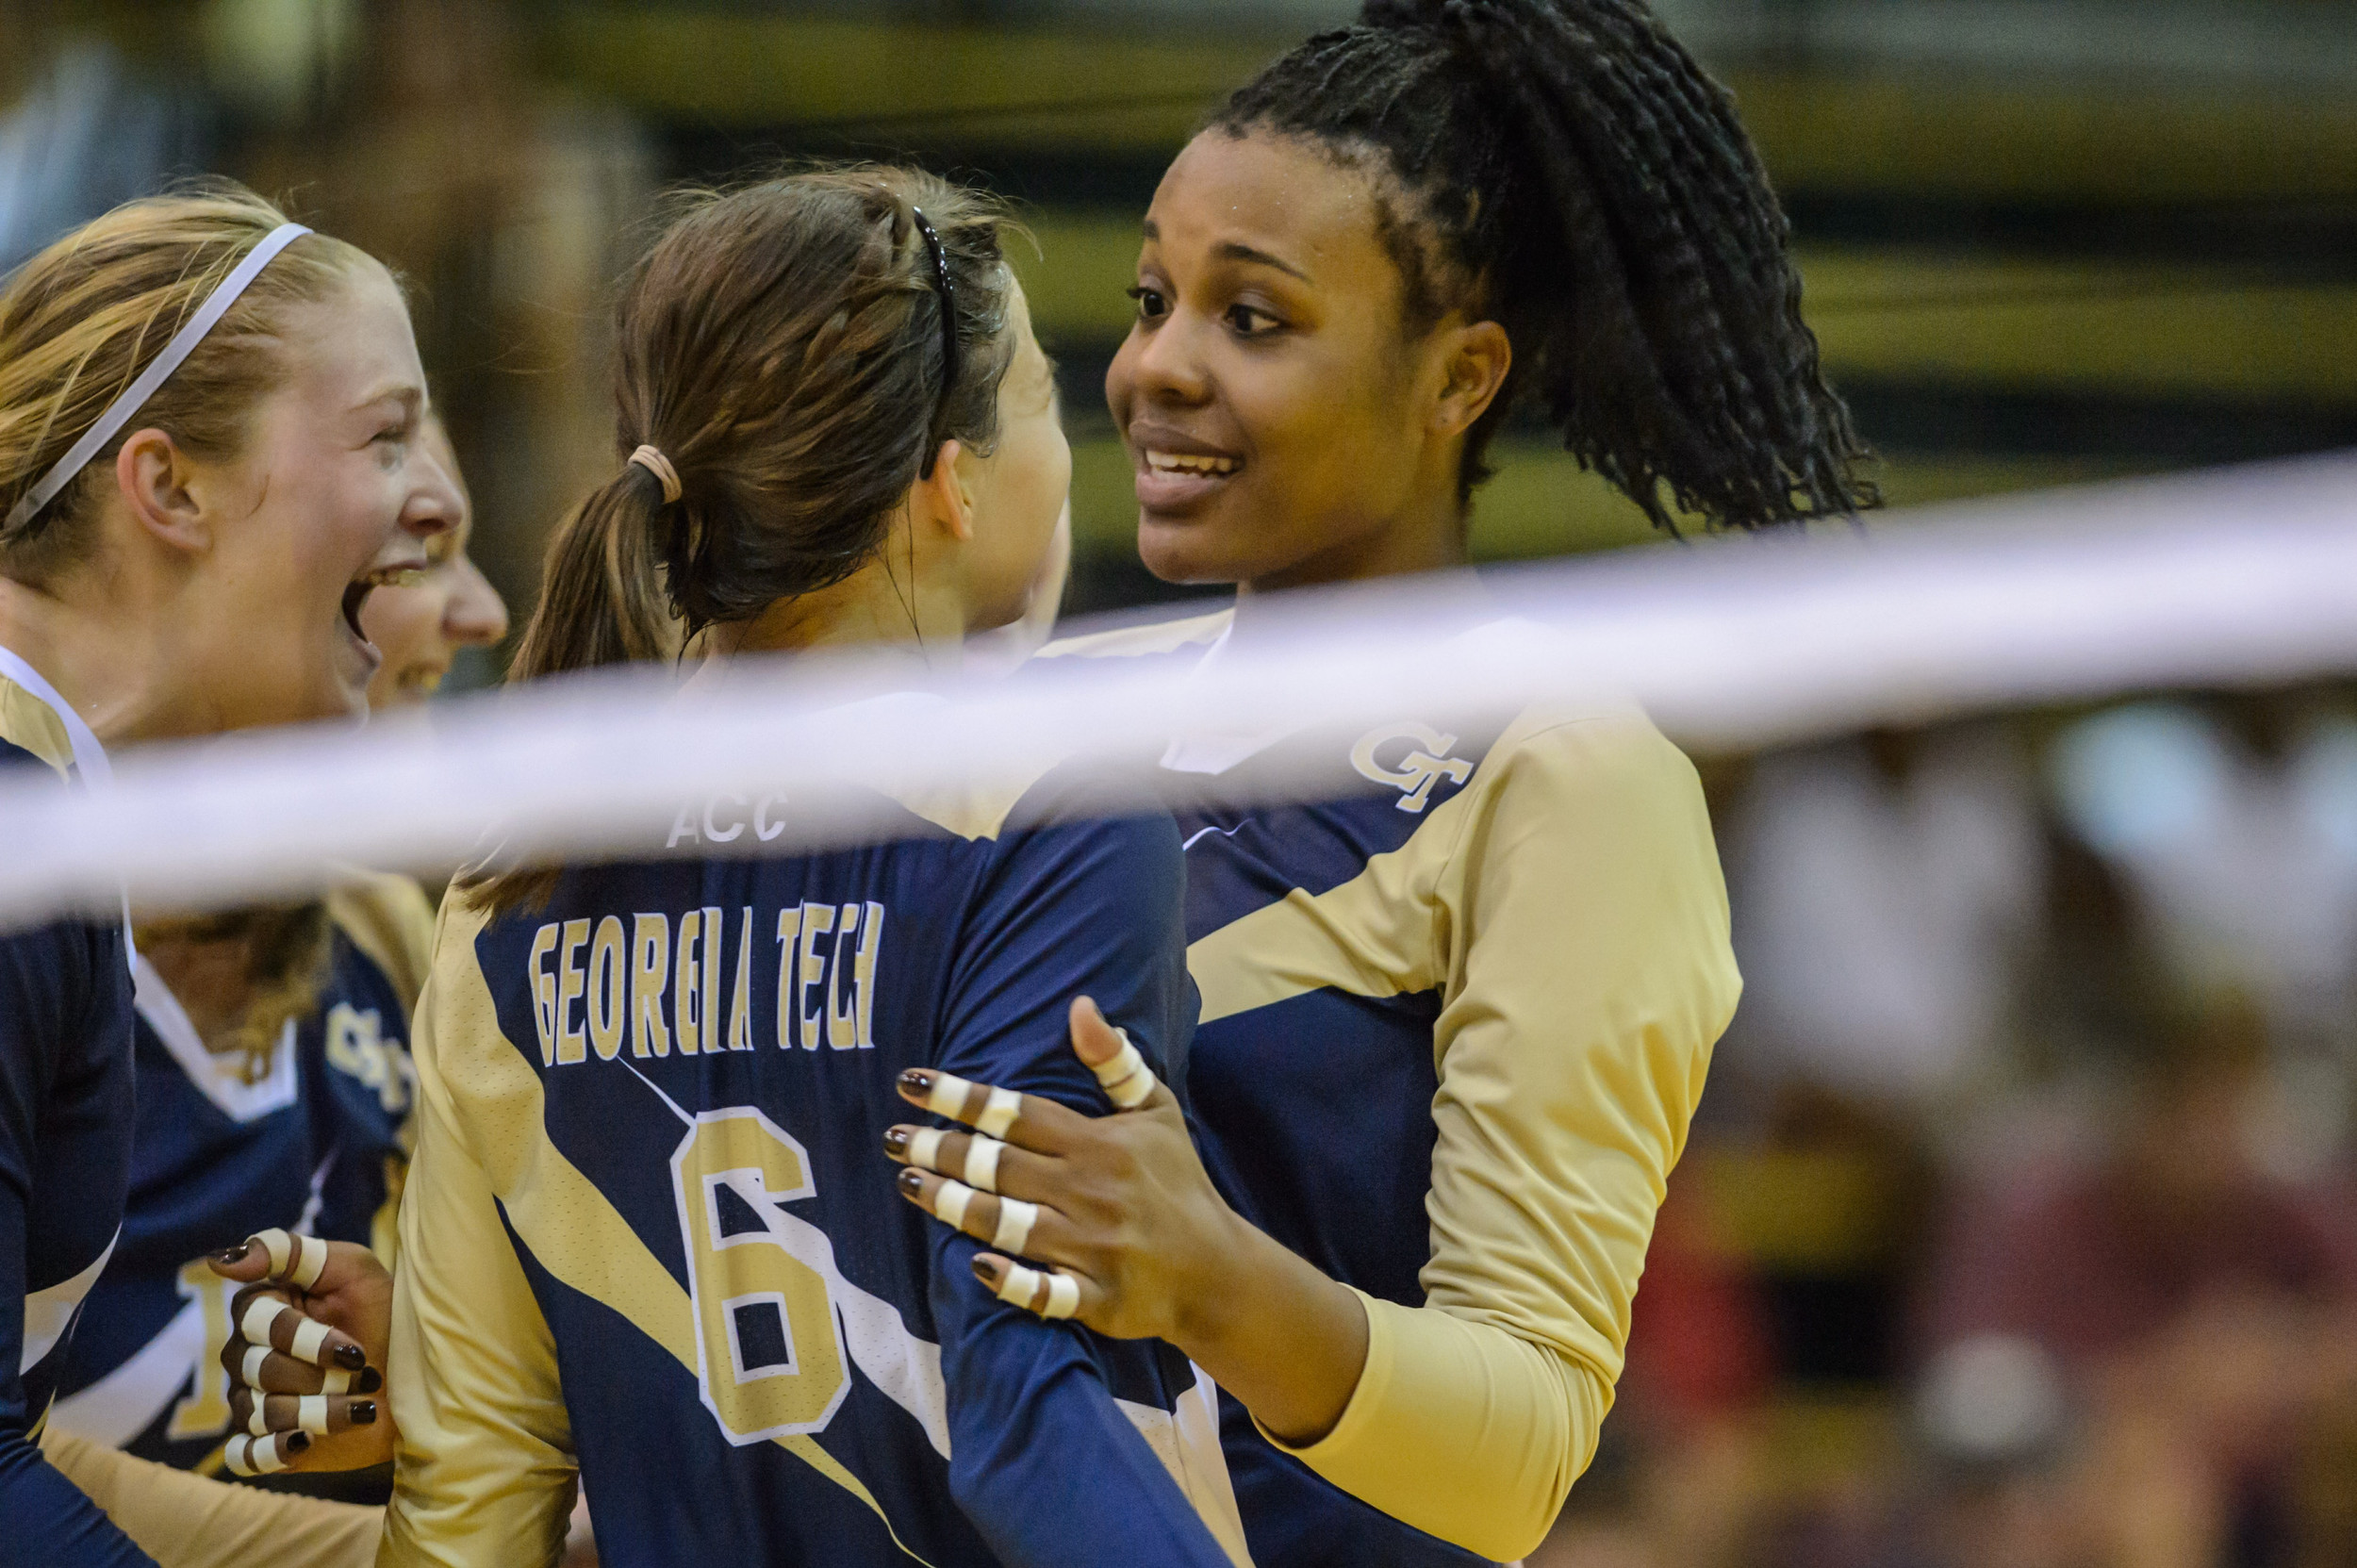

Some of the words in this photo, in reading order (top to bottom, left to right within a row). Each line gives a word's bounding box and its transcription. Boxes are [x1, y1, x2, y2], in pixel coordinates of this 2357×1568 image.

[1349, 720, 1474, 813] GT
[666, 791, 788, 849] ACC
[669, 1105, 852, 1447] 6
